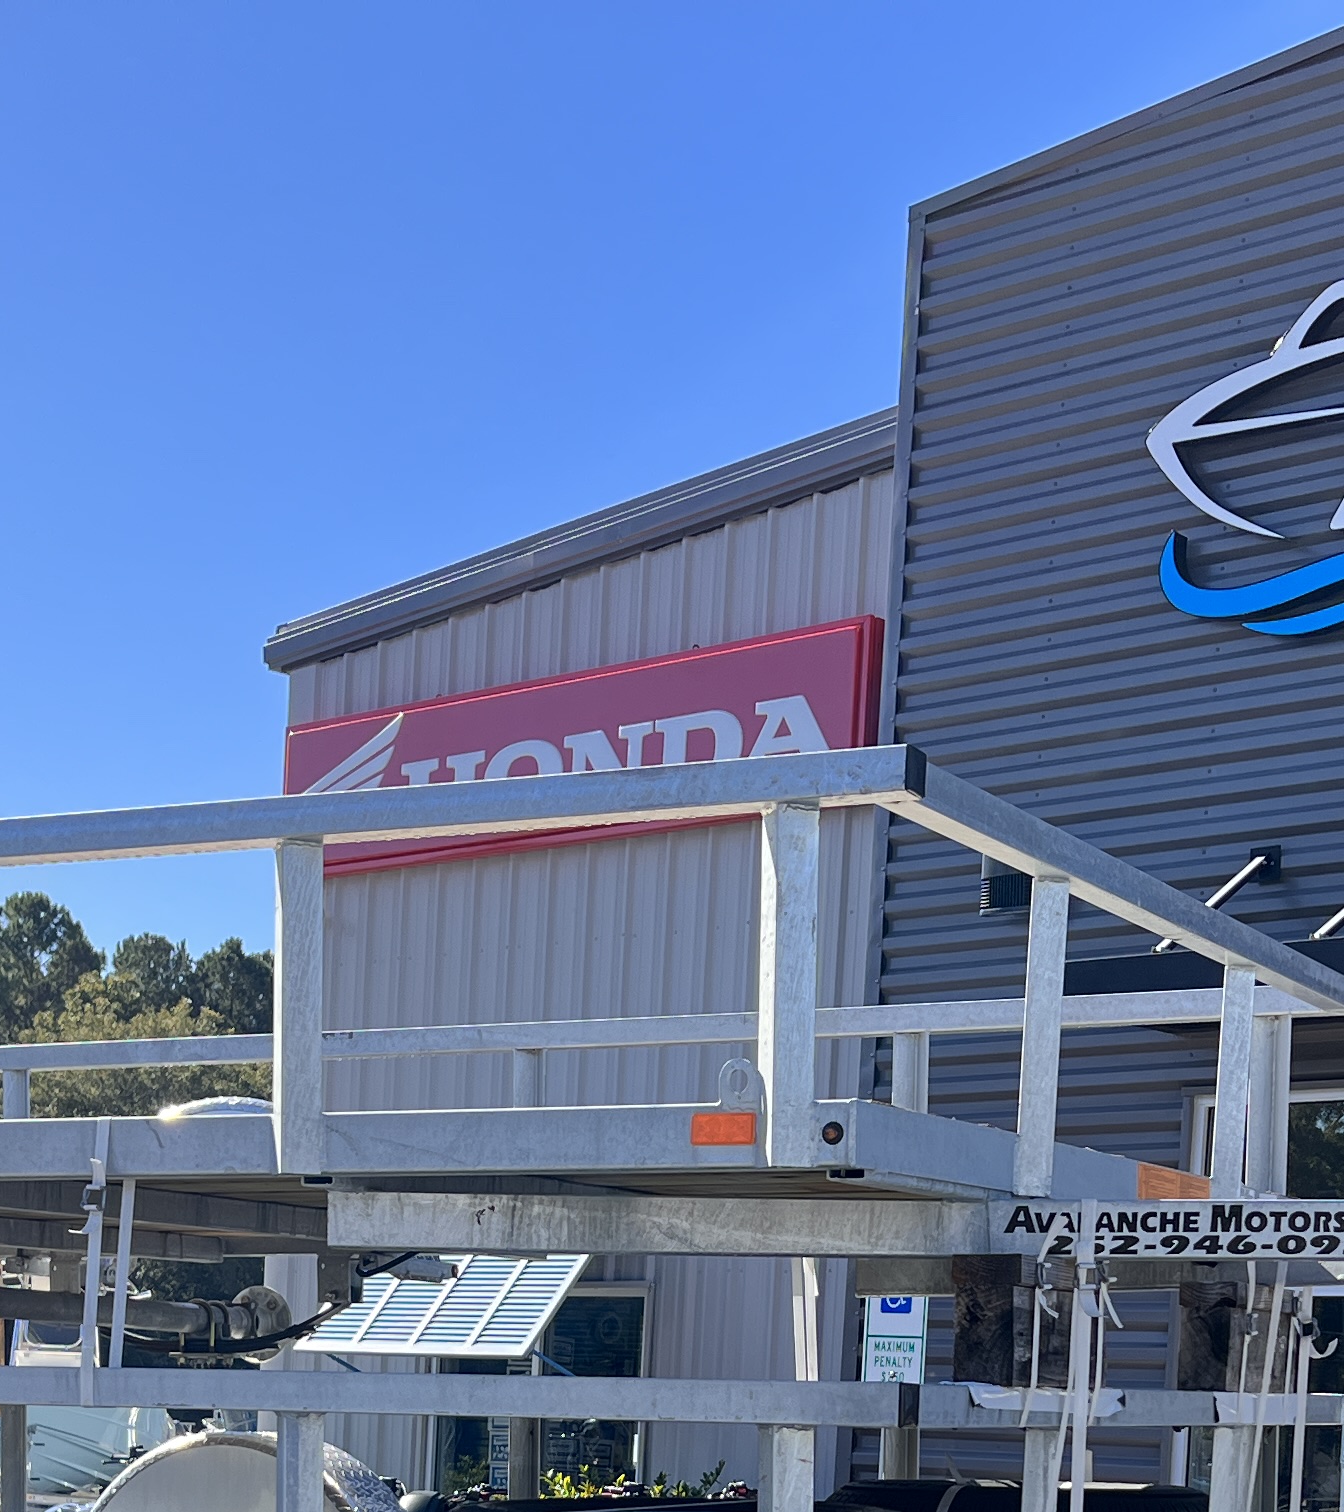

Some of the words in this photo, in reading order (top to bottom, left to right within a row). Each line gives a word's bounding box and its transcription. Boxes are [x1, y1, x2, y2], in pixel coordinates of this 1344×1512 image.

[1004, 1205, 1200, 1234] AVAANCHE
[873, 1340, 915, 1353] MAXIMUM
[873, 1356, 913, 1368] PENALTY
